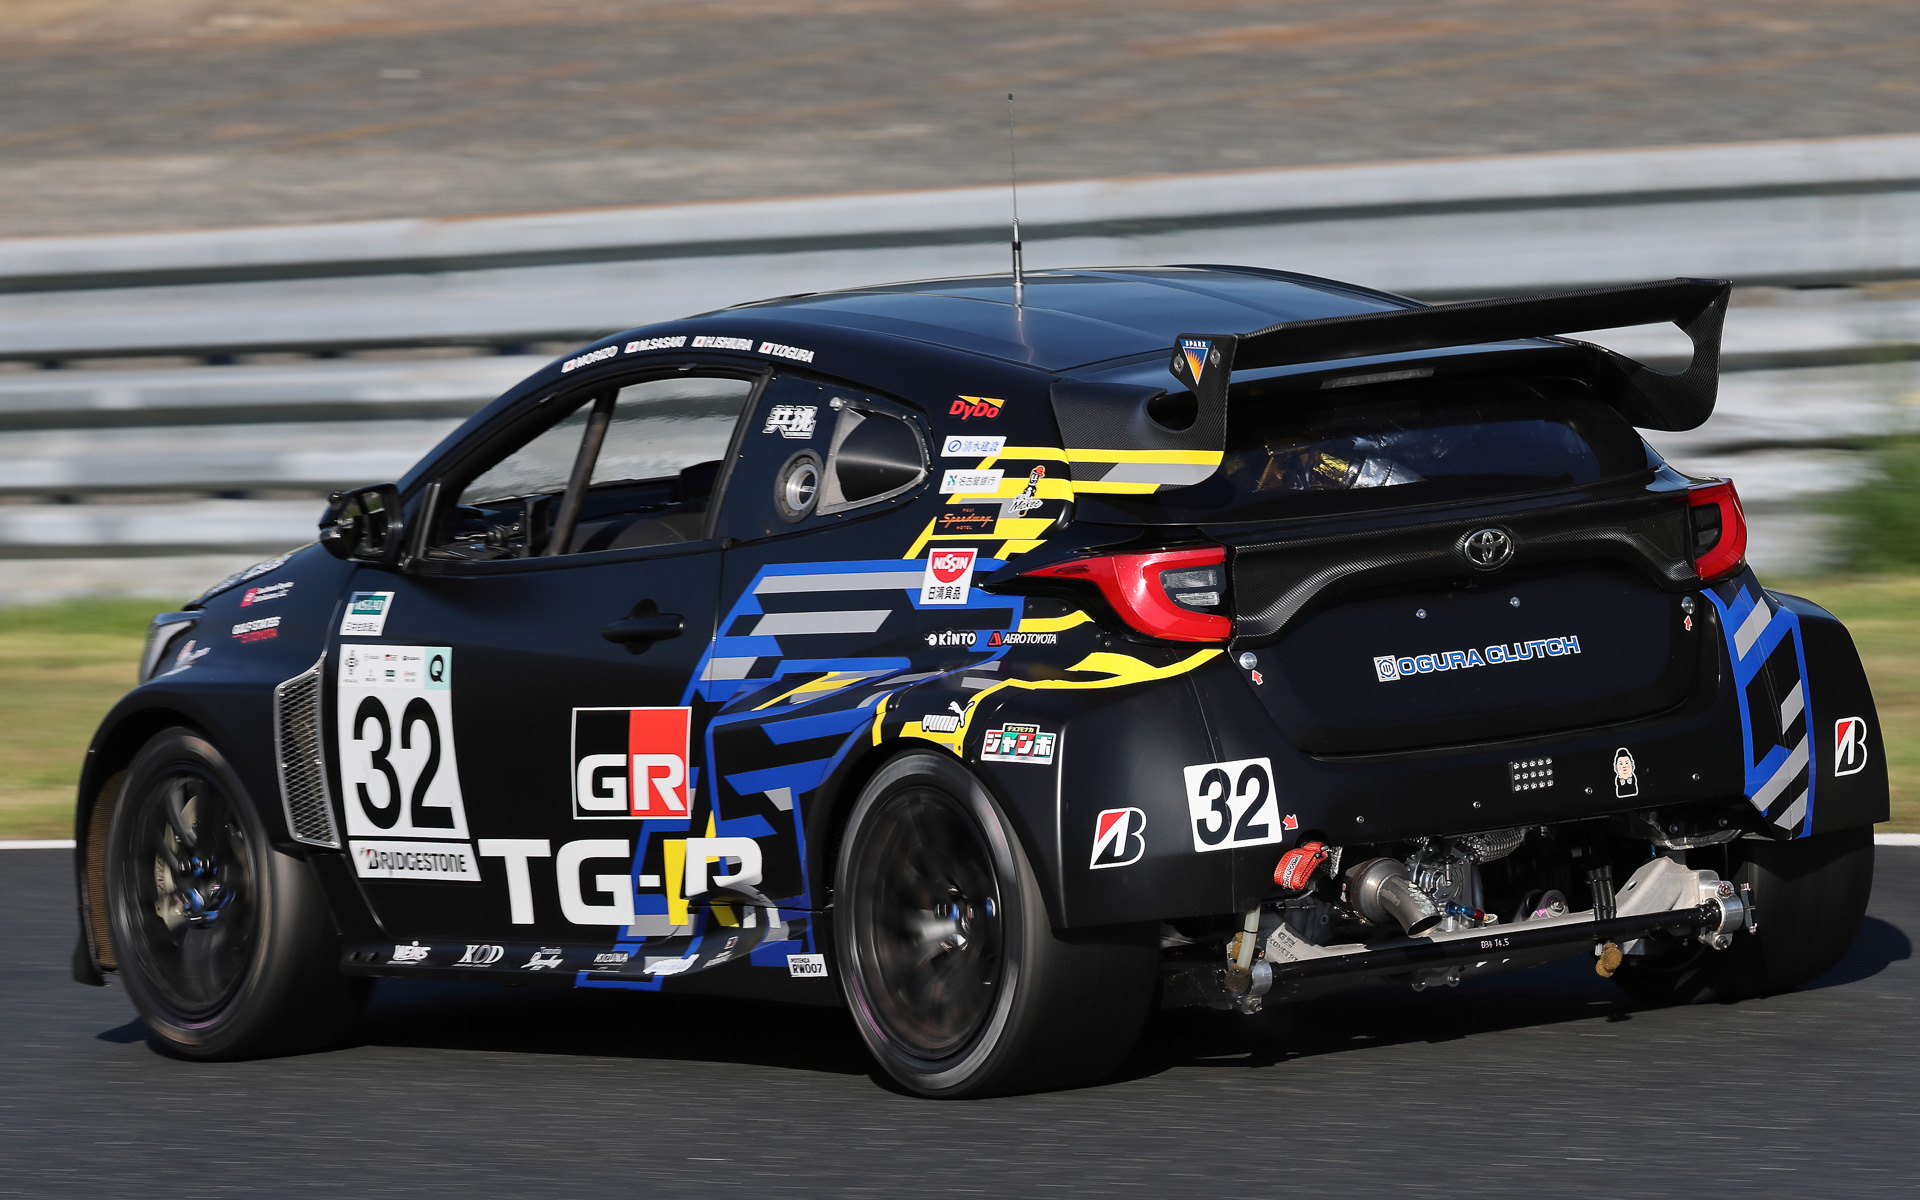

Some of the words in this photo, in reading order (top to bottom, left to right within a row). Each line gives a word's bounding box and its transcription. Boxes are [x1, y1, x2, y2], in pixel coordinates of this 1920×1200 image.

[949, 400, 1000, 420] DyDo
[940, 513, 993, 529] Speedway
[933, 554, 969, 573] NISSIN
[928, 586, 960, 600] 日清食品
[1397, 648, 1486, 676] OGURA
[1484, 635, 1581, 665] CLUTCH
[429, 654, 443, 682] Q
[985, 733, 1054, 757] ジャンボ
[353, 695, 456, 829] 32
[577, 754, 686, 810] GR
[1196, 764, 1270, 845] 32
[361, 849, 467, 873] BRIDGESTONE
[792, 963, 823, 974] RW007
